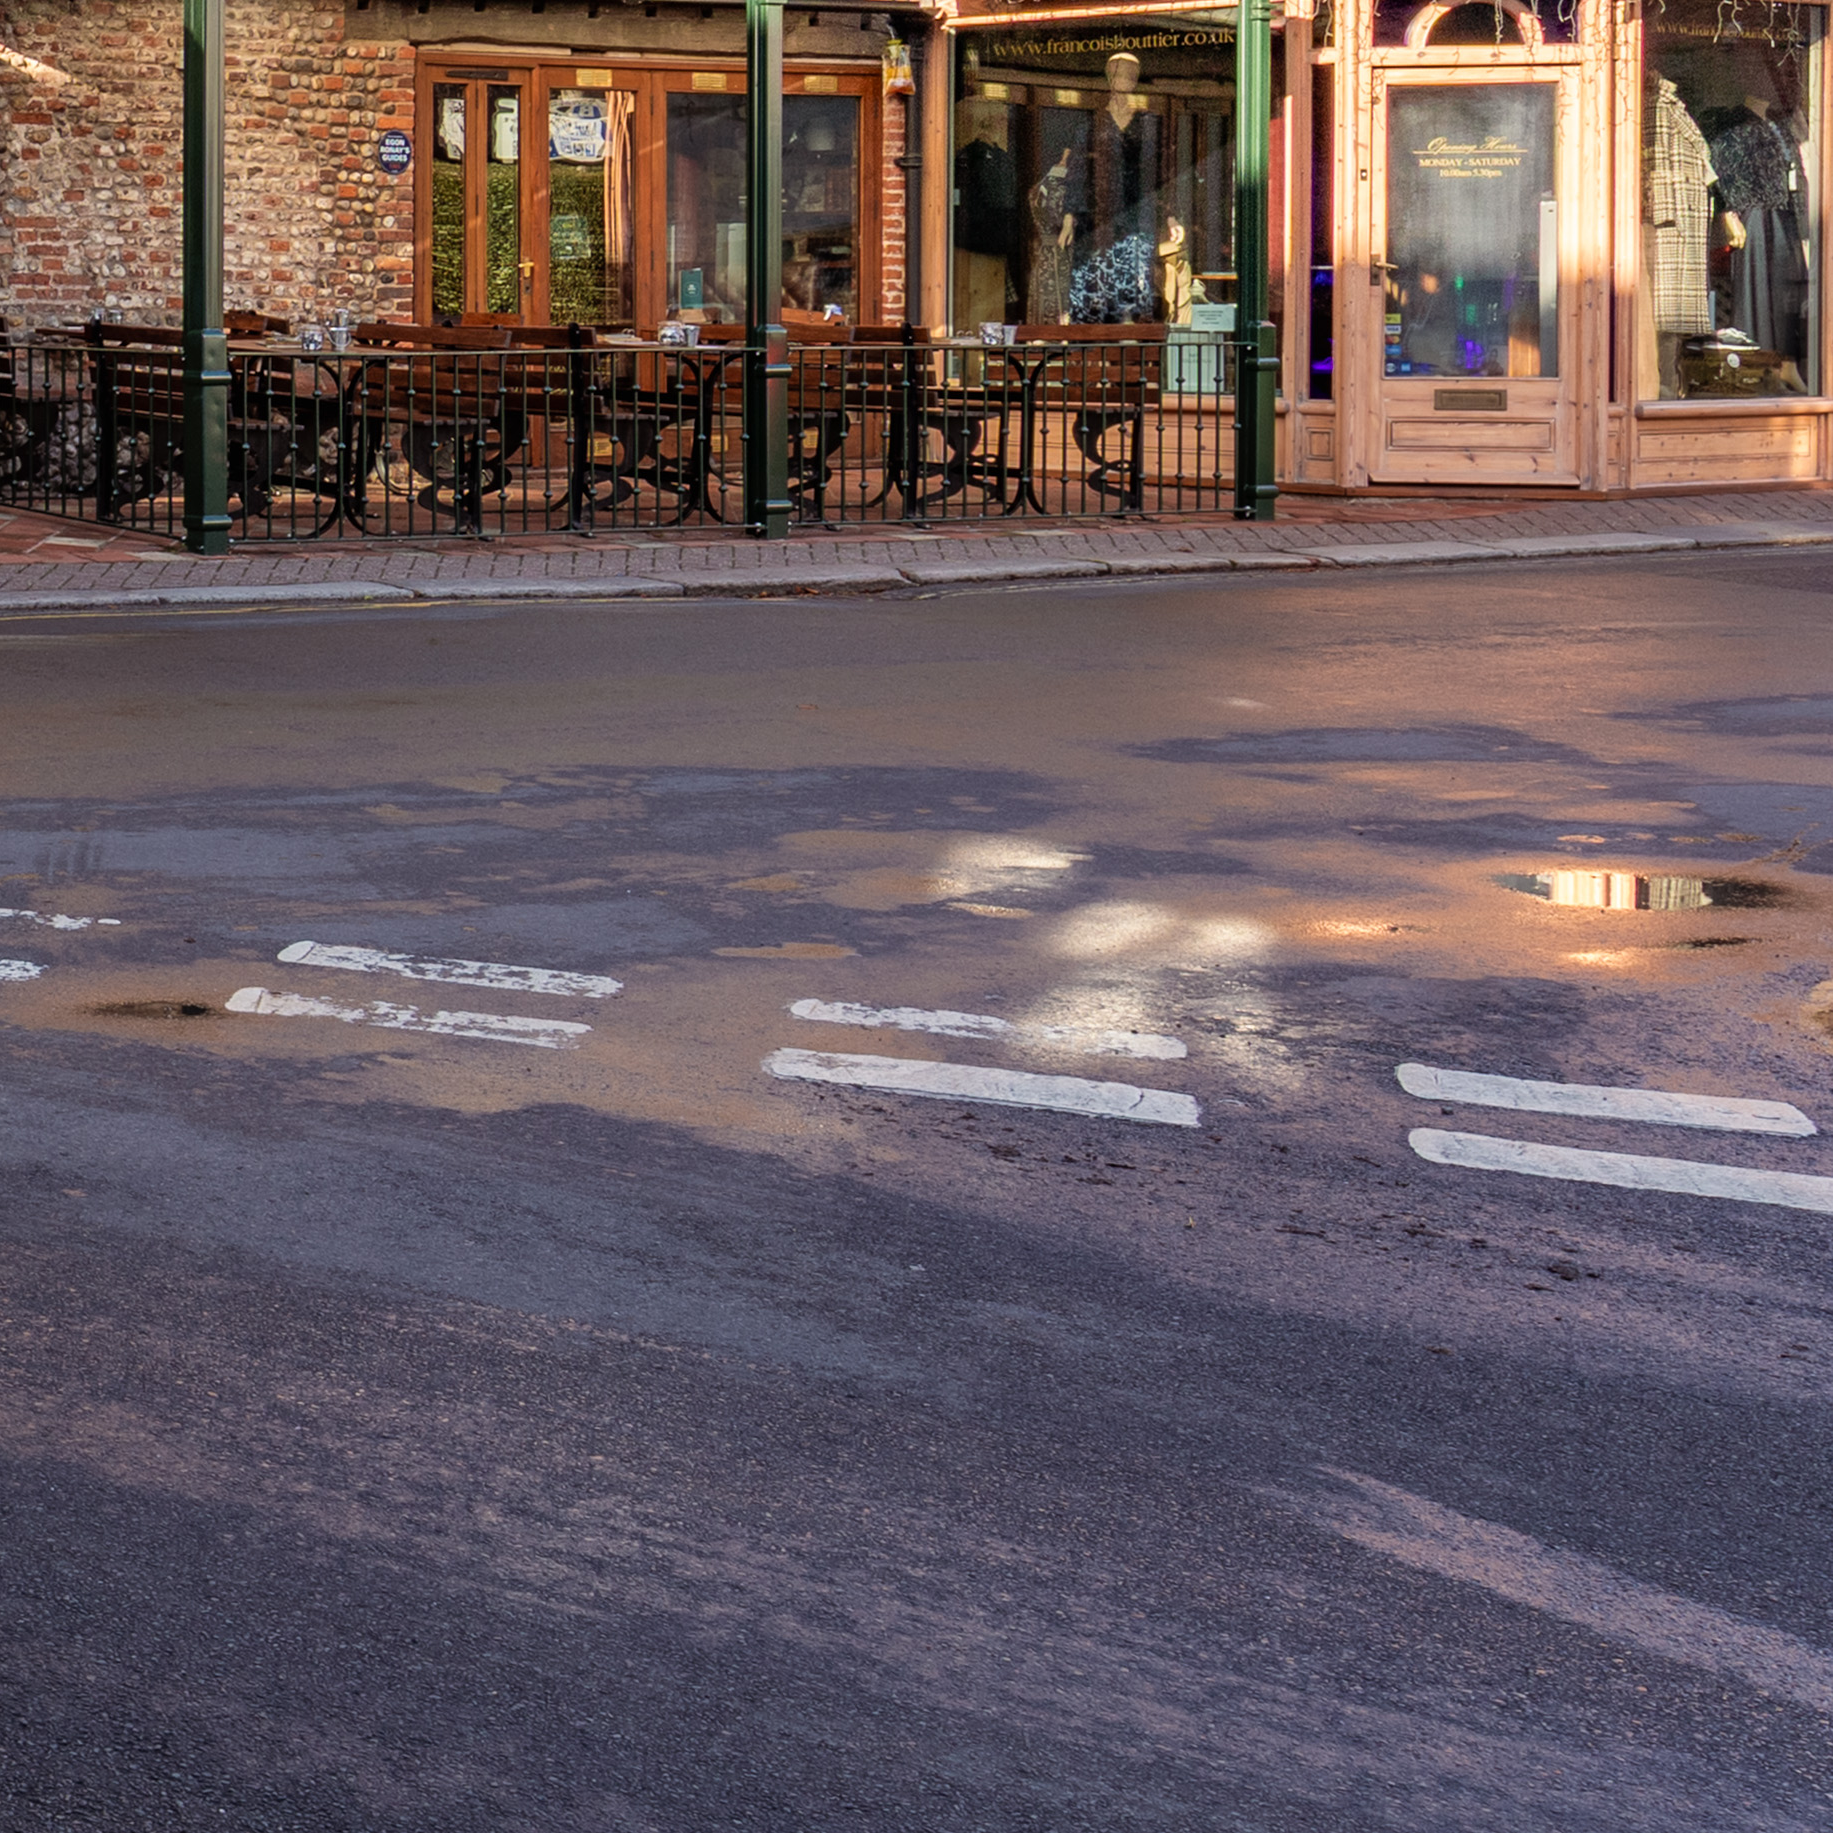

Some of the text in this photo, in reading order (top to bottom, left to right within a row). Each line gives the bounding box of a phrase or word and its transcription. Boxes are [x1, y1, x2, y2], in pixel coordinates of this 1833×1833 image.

[993, 27, 1235, 57] www.francoisbouttier.co.uk
[385, 138, 405, 146] EGON
[382, 154, 408, 162] GUIDES
[1419, 158, 1463, 167] MONDAY
[1468, 157, 1522, 166] SATURDAY
